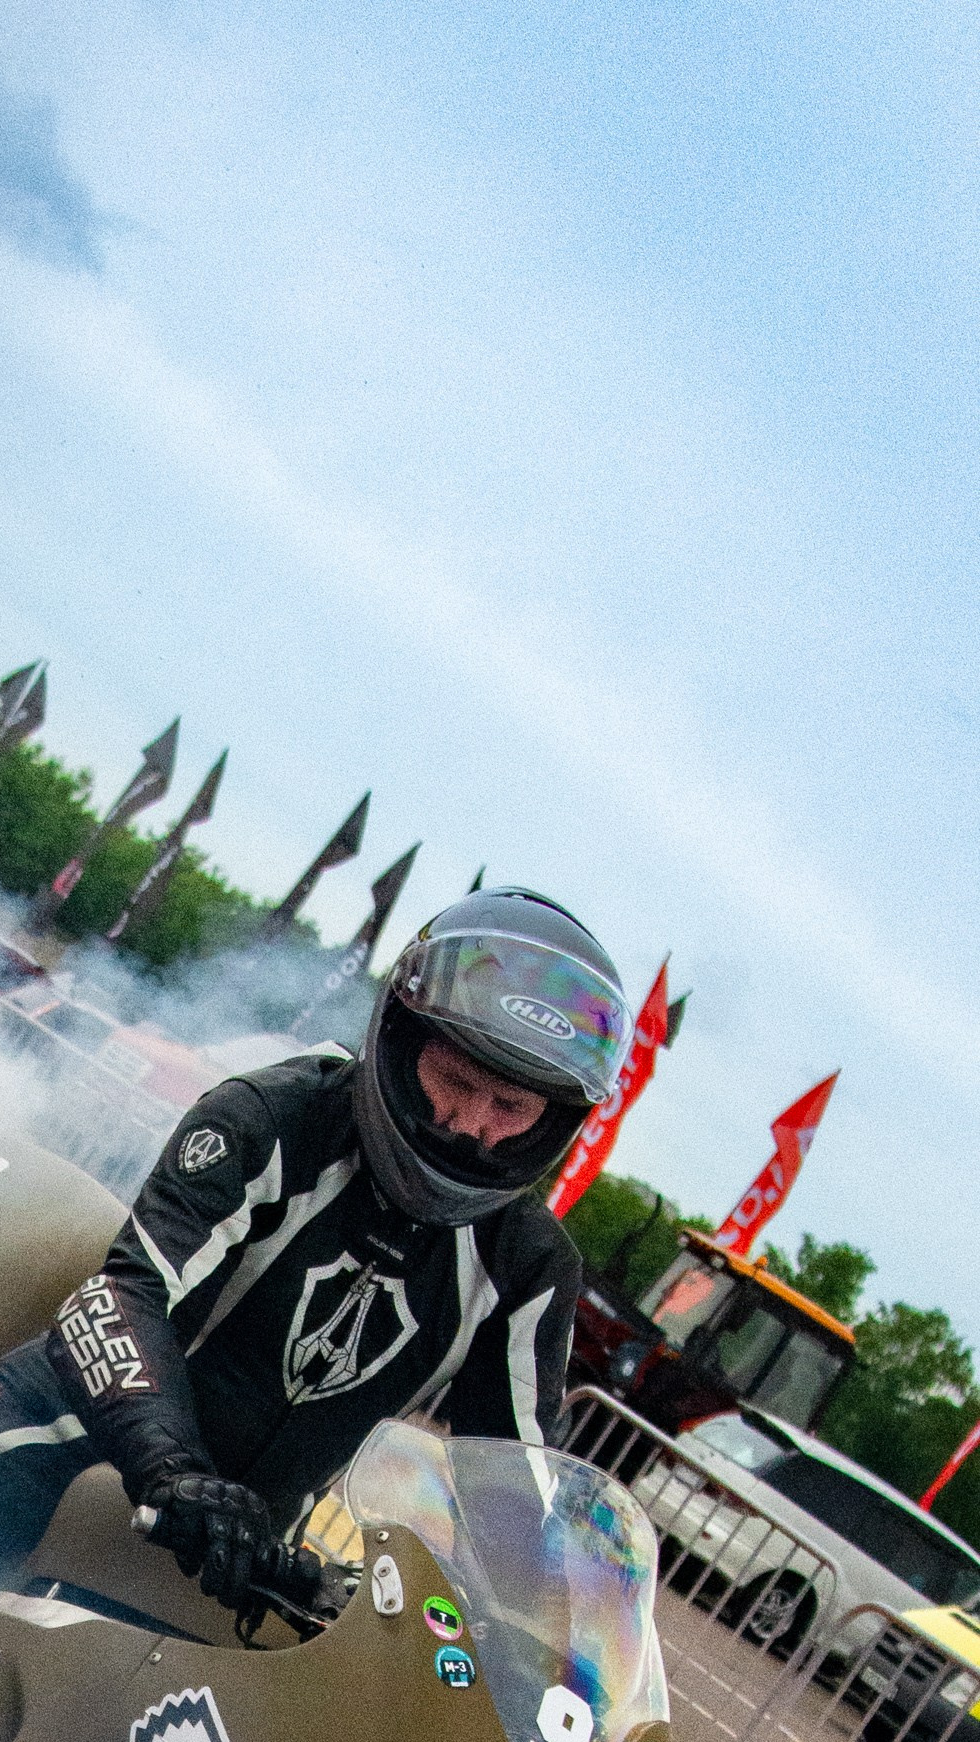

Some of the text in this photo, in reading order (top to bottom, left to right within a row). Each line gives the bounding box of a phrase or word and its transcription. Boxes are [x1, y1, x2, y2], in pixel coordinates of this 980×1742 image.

[509, 999, 569, 1036] HJC
[54, 1292, 113, 1398] NESS
[80, 1274, 151, 1390] ARLEN
[439, 1612, 448, 1623] T
[443, 1661, 467, 1673] M-3
